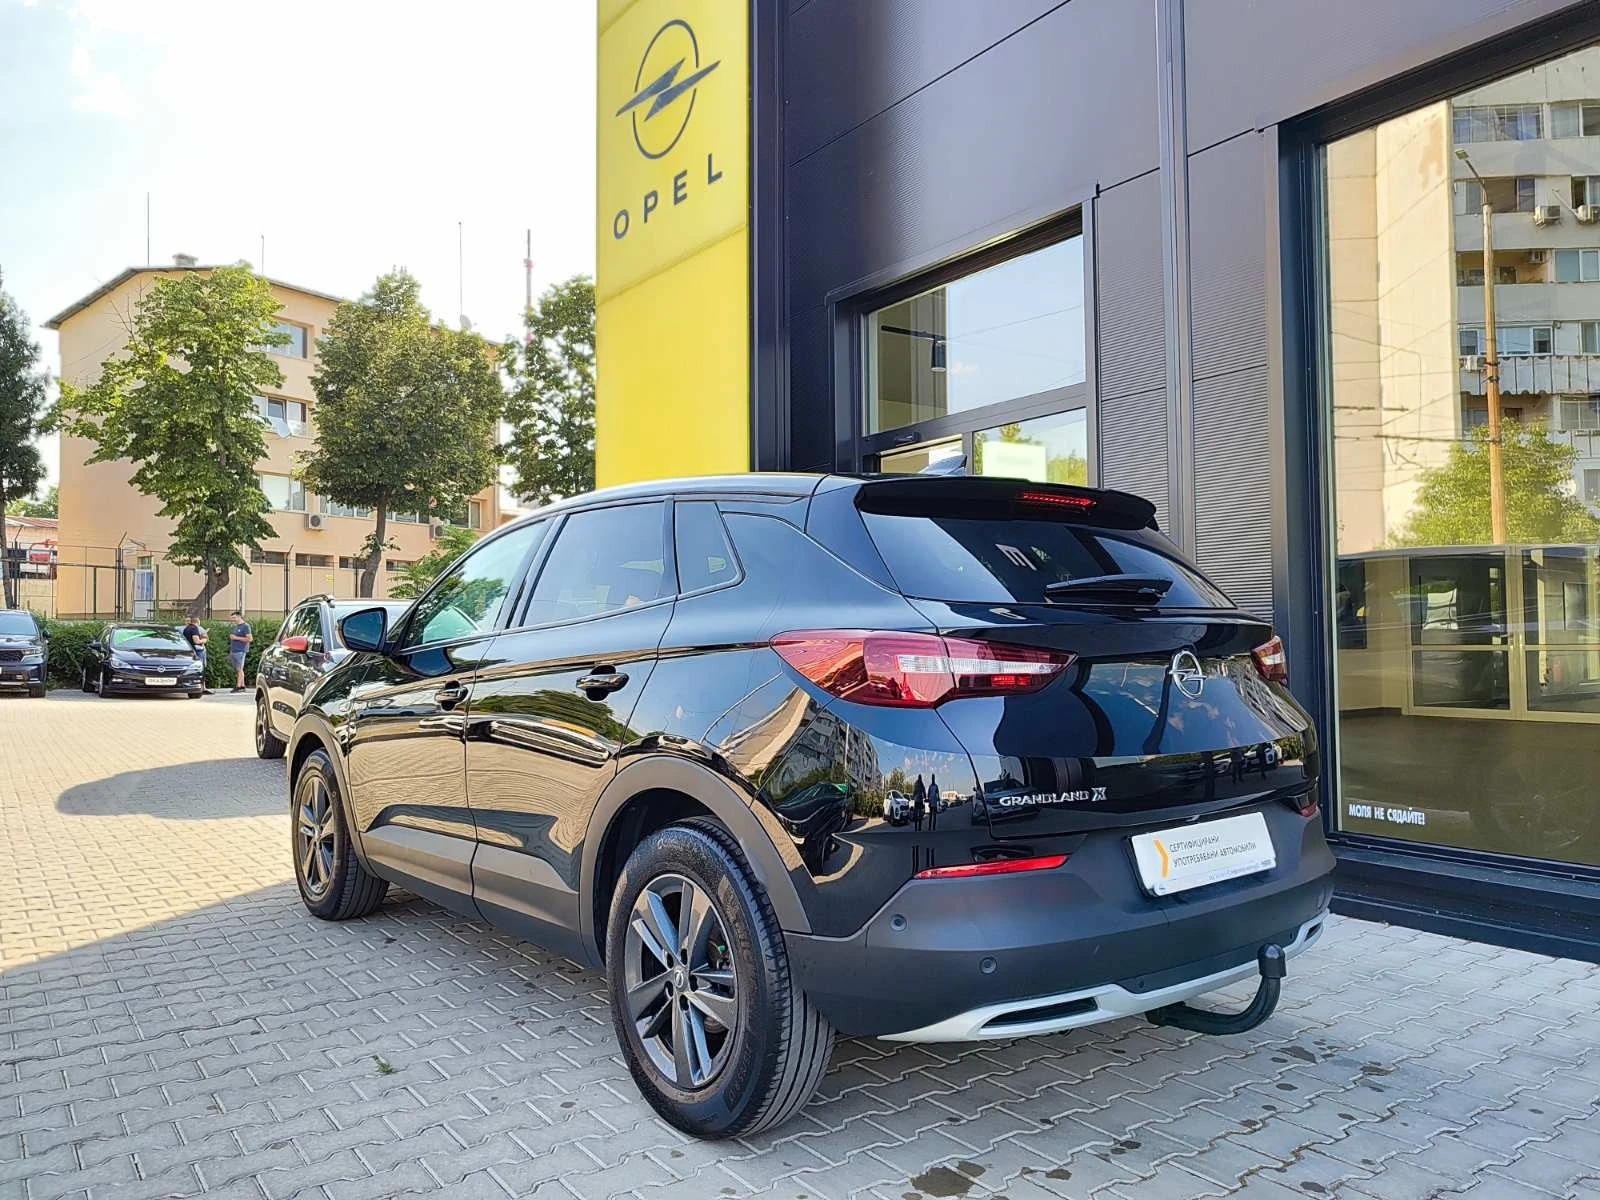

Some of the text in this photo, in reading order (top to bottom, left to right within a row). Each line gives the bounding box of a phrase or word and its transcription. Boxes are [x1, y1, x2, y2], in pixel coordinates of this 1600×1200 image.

[613, 153, 723, 240] OPEL
[999, 786, 1107, 807] GRANDLAND X
[1374, 806, 1385, 820] НЕ
